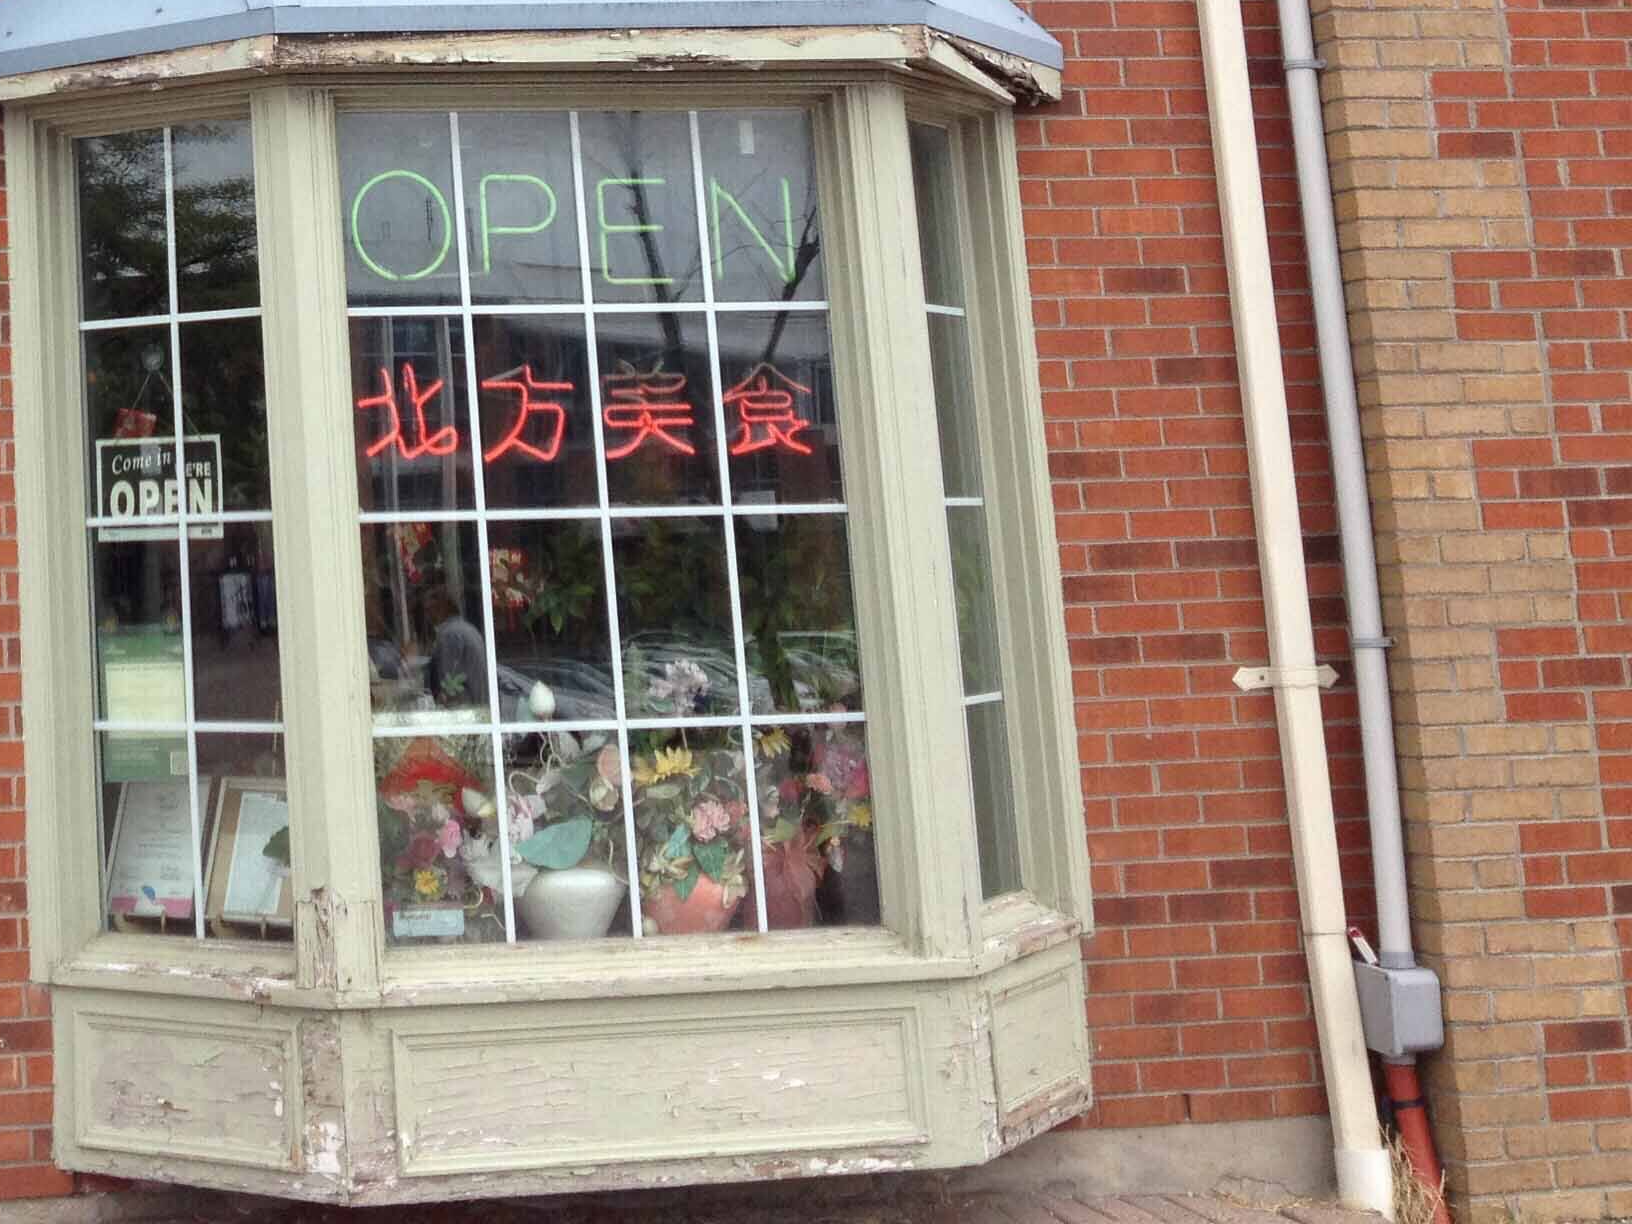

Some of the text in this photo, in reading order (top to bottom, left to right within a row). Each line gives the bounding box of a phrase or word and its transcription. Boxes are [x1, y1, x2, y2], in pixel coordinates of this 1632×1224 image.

[351, 169, 797, 285] OPEN
[357, 360, 812, 464] 北方美食
[110, 478, 213, 519] OPEN
[176, 461, 212, 477] E'RE
